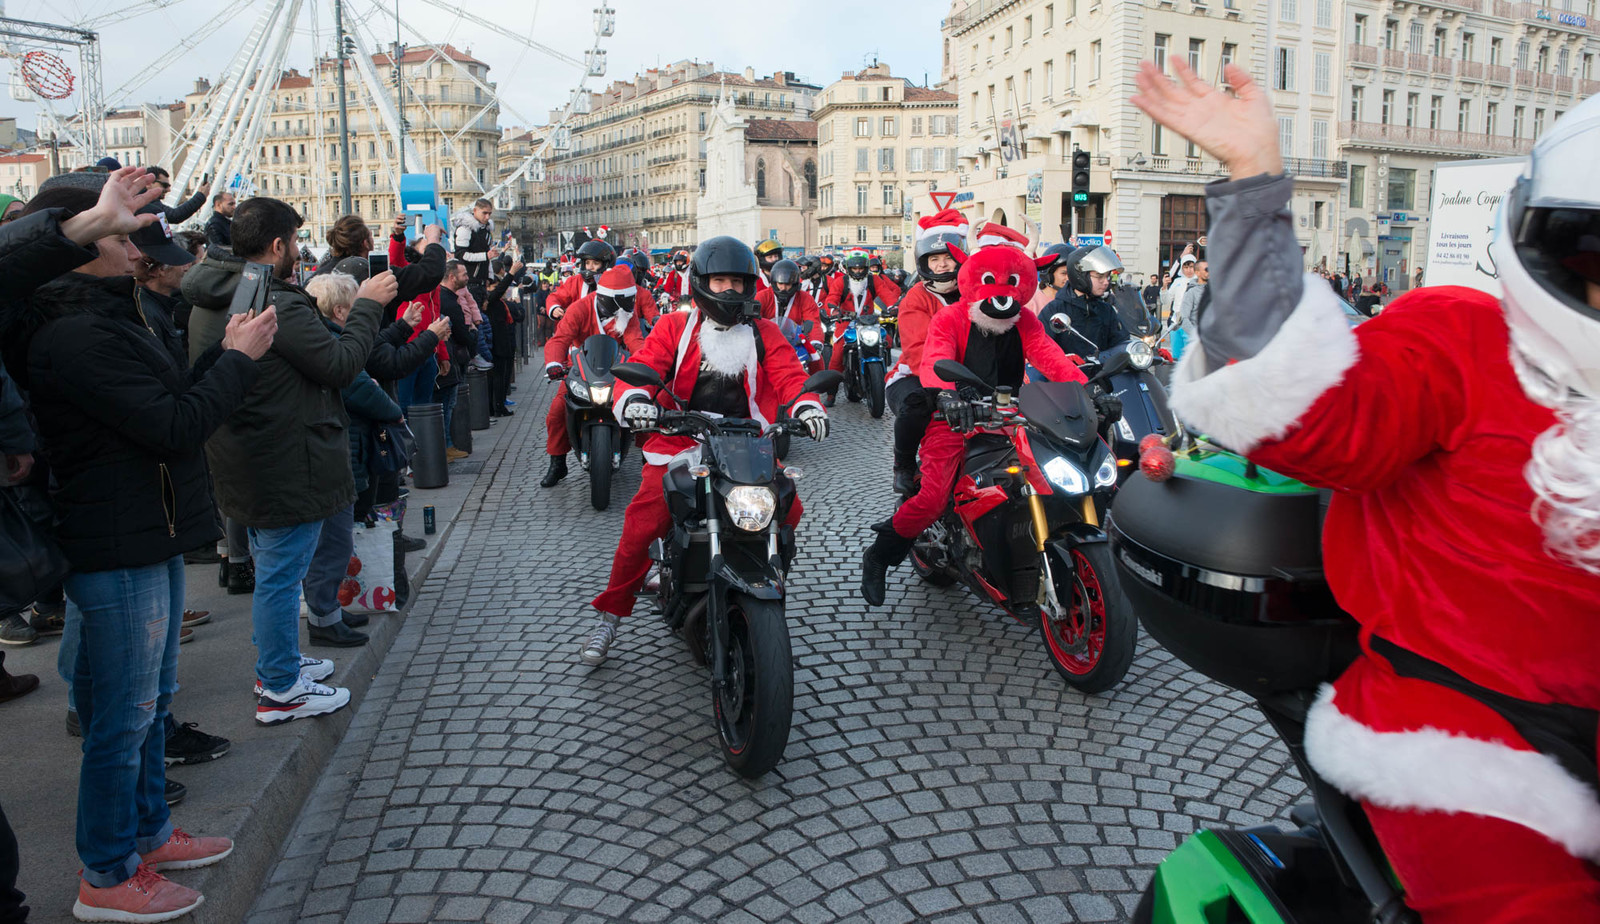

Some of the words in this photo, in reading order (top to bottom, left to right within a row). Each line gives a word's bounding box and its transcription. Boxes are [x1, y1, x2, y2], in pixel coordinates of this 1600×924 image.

[1074, 193, 1087, 201] BUS
[1439, 190, 1471, 209] Joaline
[1440, 232, 1469, 240] Livraisons
